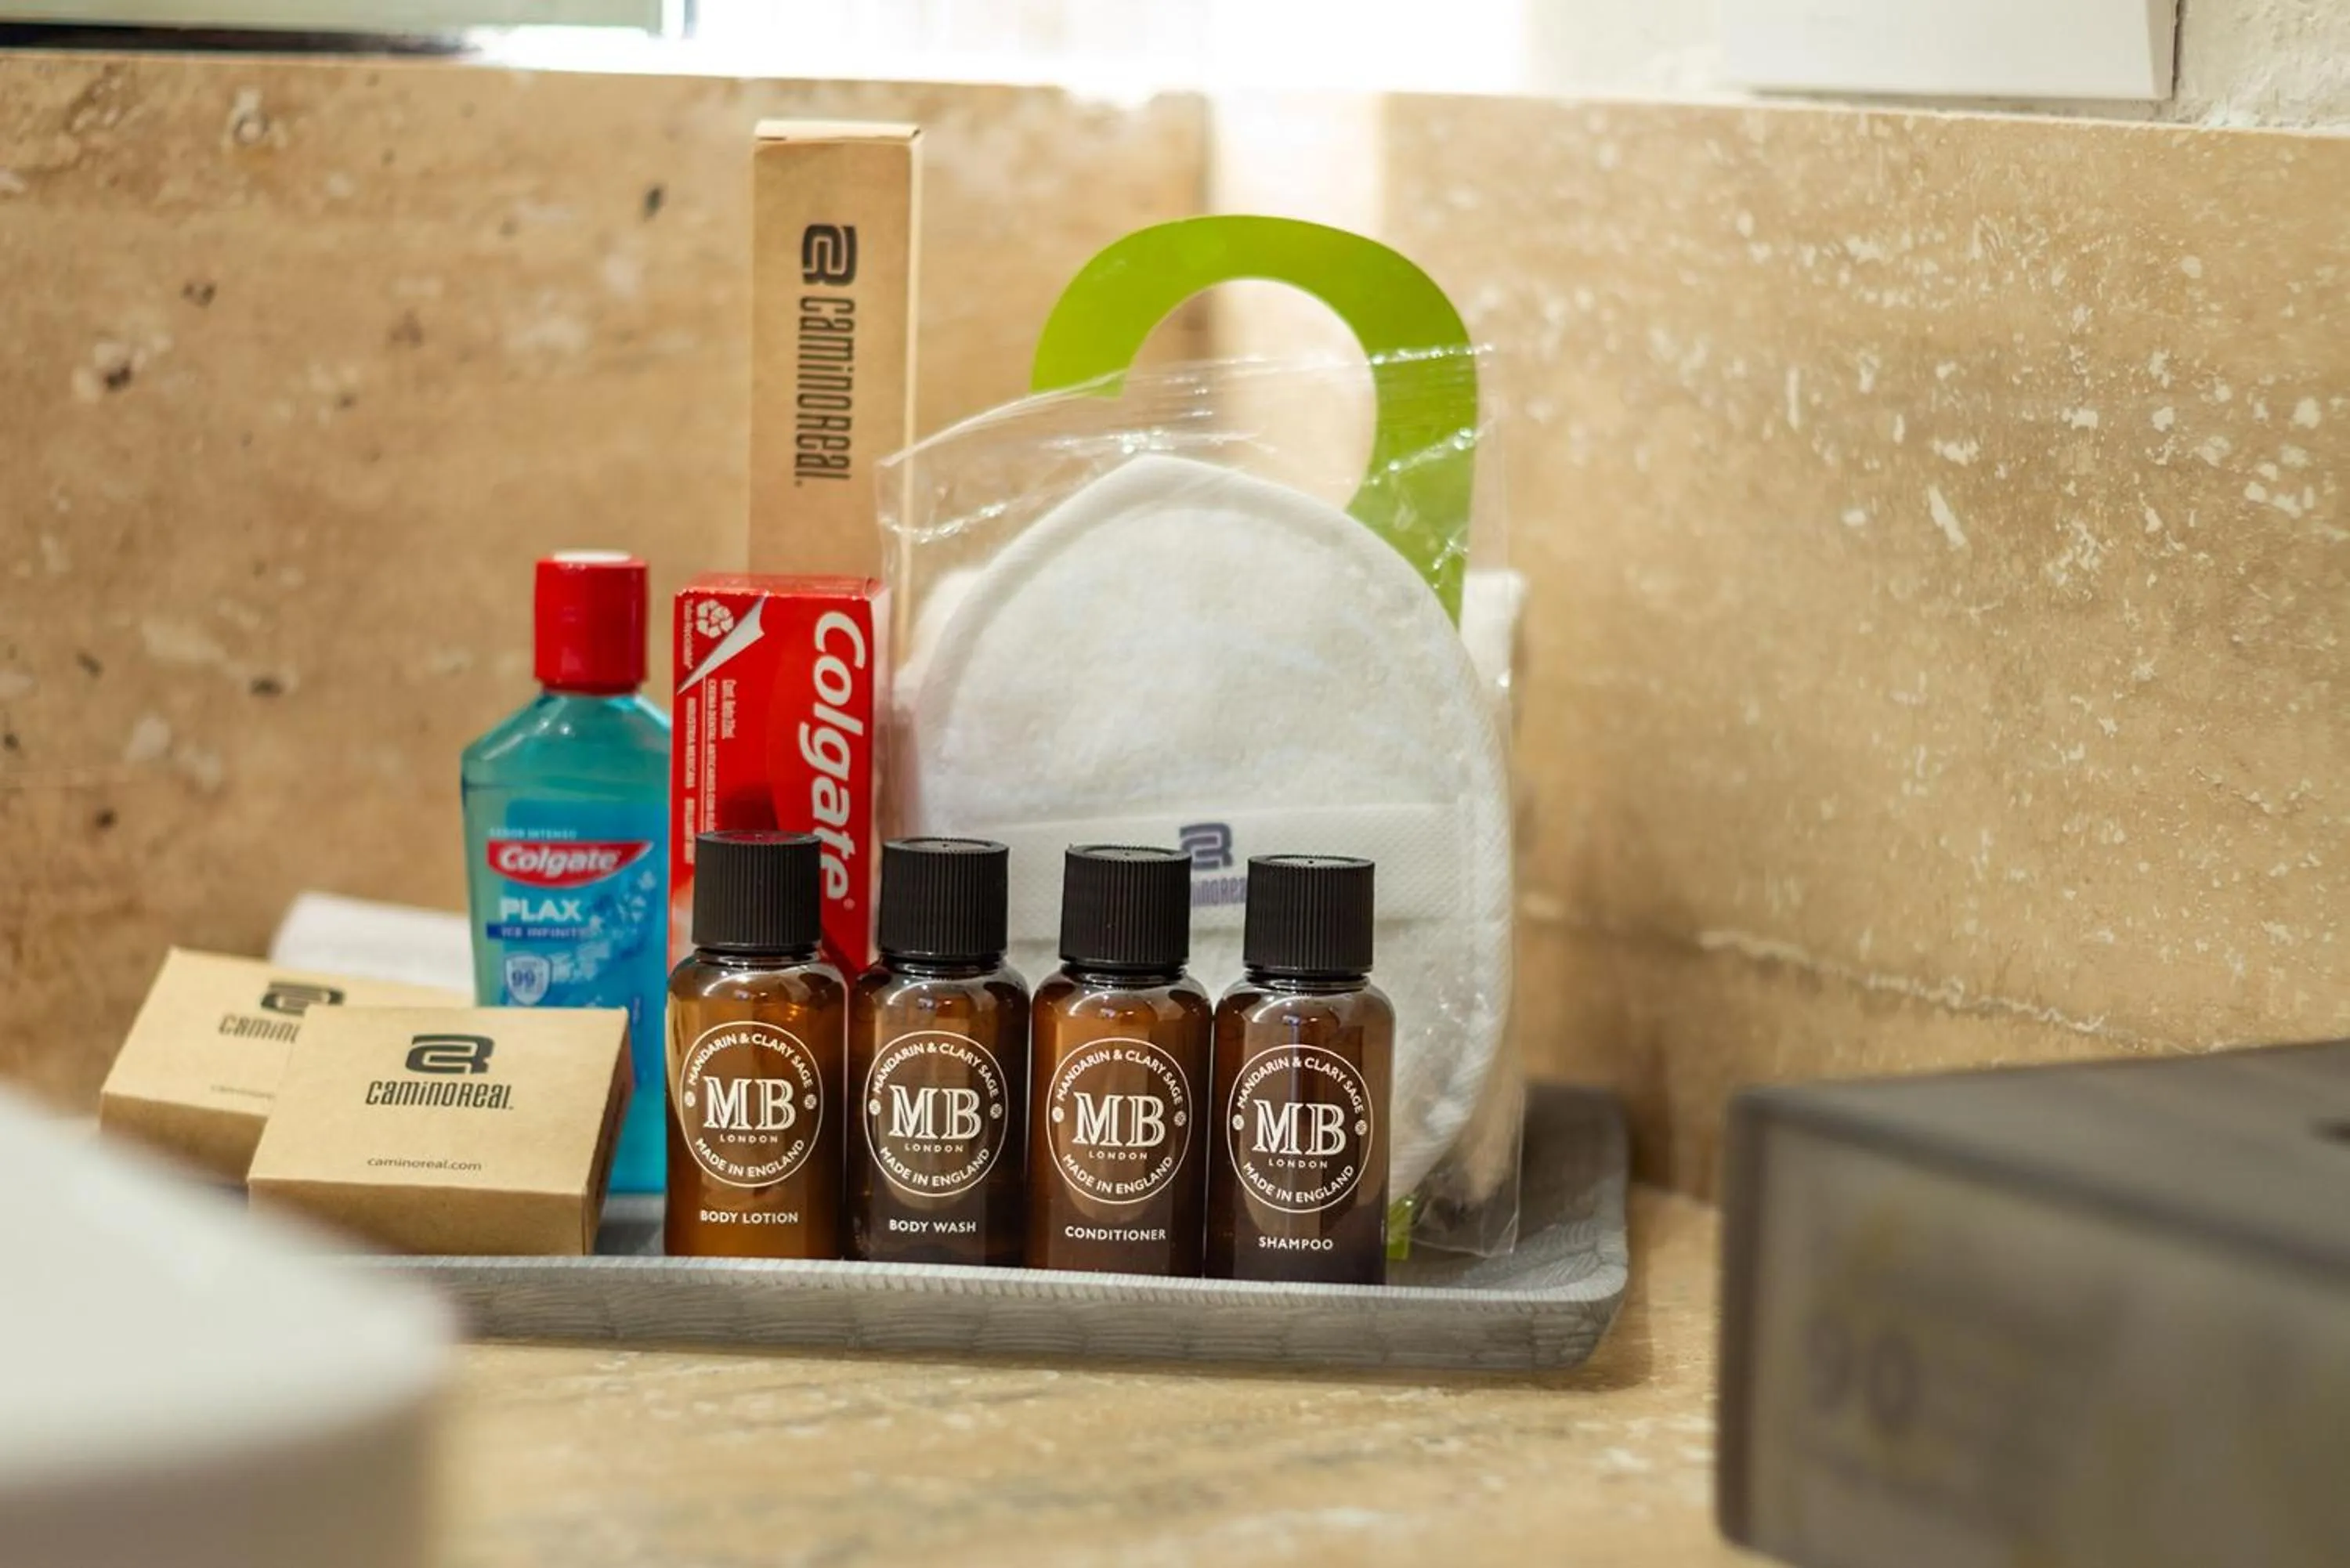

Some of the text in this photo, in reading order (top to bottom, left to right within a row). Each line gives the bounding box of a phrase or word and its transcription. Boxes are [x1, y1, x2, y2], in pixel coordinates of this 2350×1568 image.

[798, 611, 866, 901] Colgate
[499, 845, 620, 878] Colgate
[500, 897, 583, 923] PLAX
[688, 1032, 814, 1089] MANDARIN & CLARY SAGE
[873, 1042, 1000, 1099] MANDARIN & CLARY SAGE
[1057, 1050, 1184, 1106] MANDARIN & CLARY SAGE
[703, 1075, 797, 1130] MB
[1237, 1056, 1365, 1115] MANDARIN & CLARY SAGE
[888, 1085, 982, 1140] MB
[1072, 1091, 1166, 1147] MB
[1252, 1099, 1347, 1155] MB
[695, 1138, 804, 1177] MADE IN ENGLAND
[720, 1134, 778, 1143] LONDON
[904, 1143, 964, 1153] LONDON
[1089, 1151, 1148, 1160] LONDON
[367, 1156, 483, 1172] caminoreal.com
[880, 1147, 989, 1187] MADE IN ENGLAND
[1063, 1154, 1173, 1194] MADE IN ENGLAND
[1243, 1162, 1354, 1203] MADE IN ENGLAND
[1268, 1159, 1328, 1169] LONDON
[700, 1210, 798, 1224] BODY LOTION
[888, 1219, 976, 1232] BODY WASH
[1065, 1226, 1166, 1241] CONDITIONER
[1259, 1236, 1333, 1251] SHAMPOO
